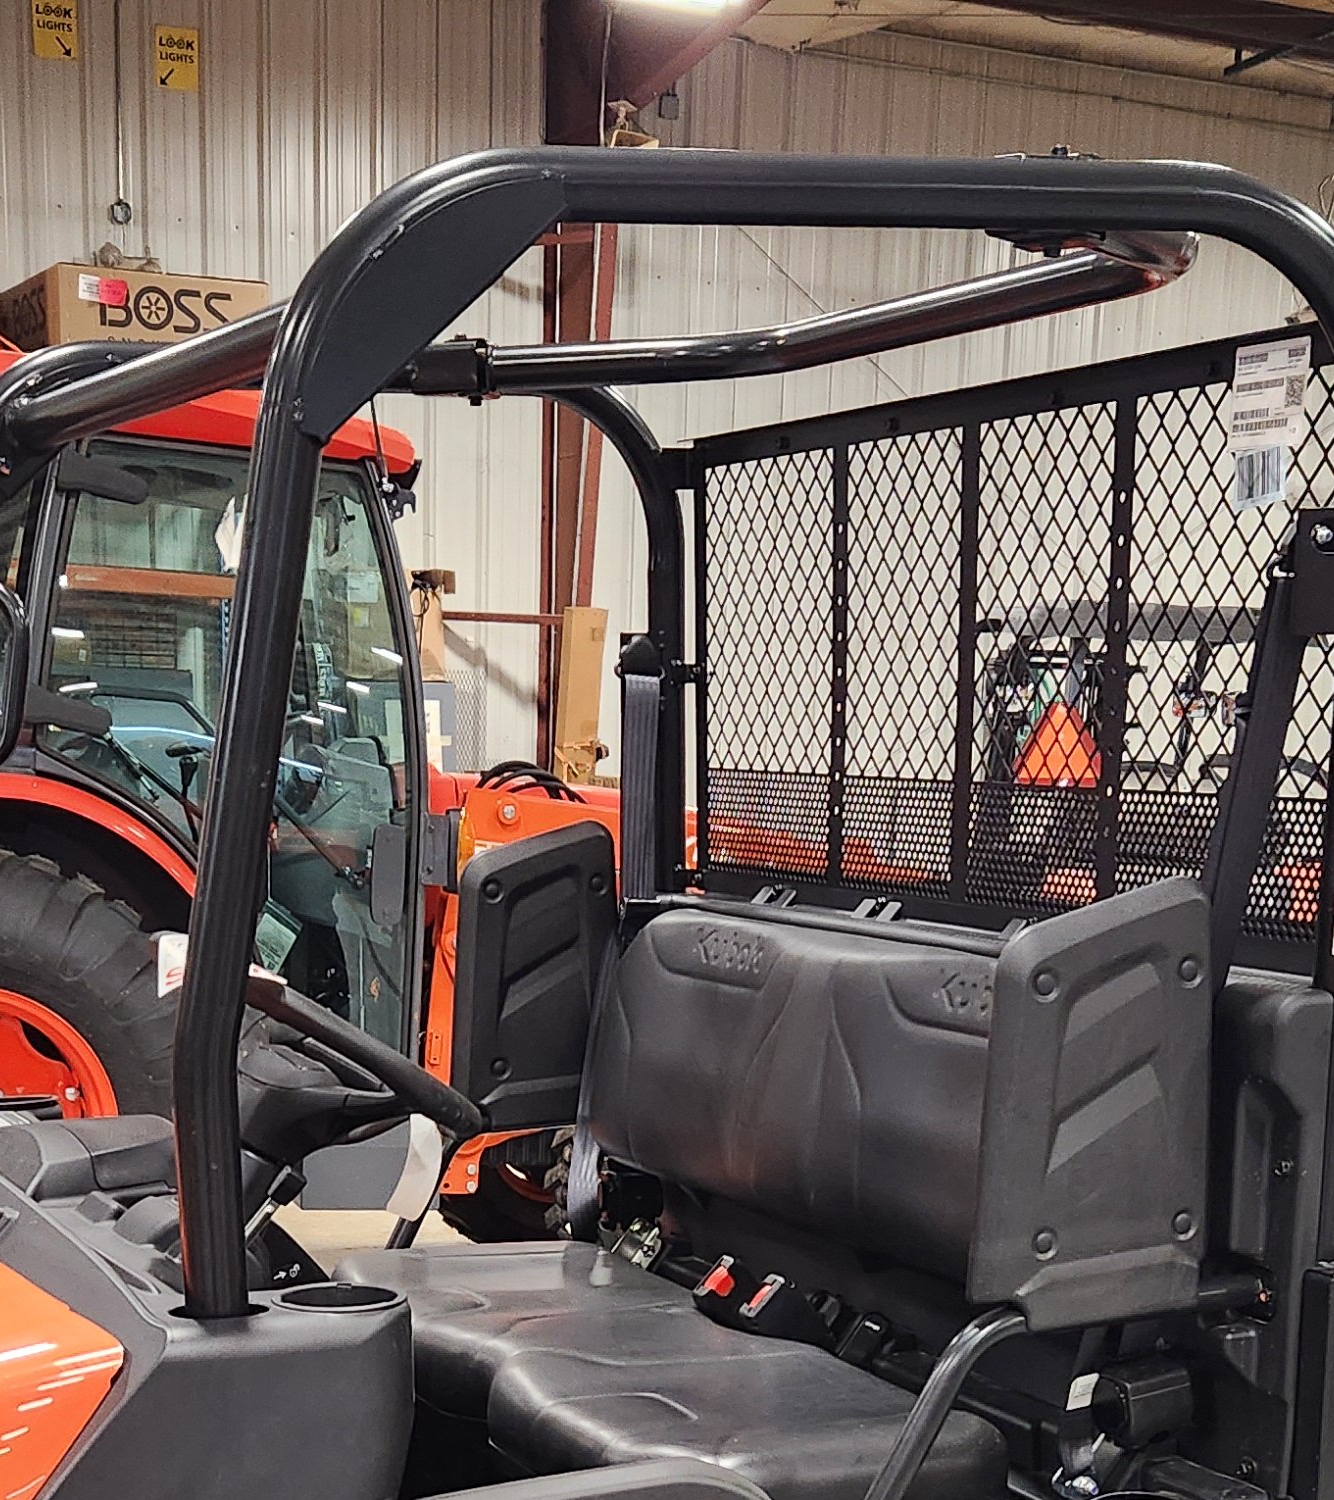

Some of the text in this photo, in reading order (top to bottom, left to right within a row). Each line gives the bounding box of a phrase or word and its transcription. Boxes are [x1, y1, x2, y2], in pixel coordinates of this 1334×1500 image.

[35, 2, 73, 19] LOOK
[36, 20, 73, 33] LIGHTS
[158, 35, 195, 51] LOOK
[159, 51, 195, 64] LIGHTS
